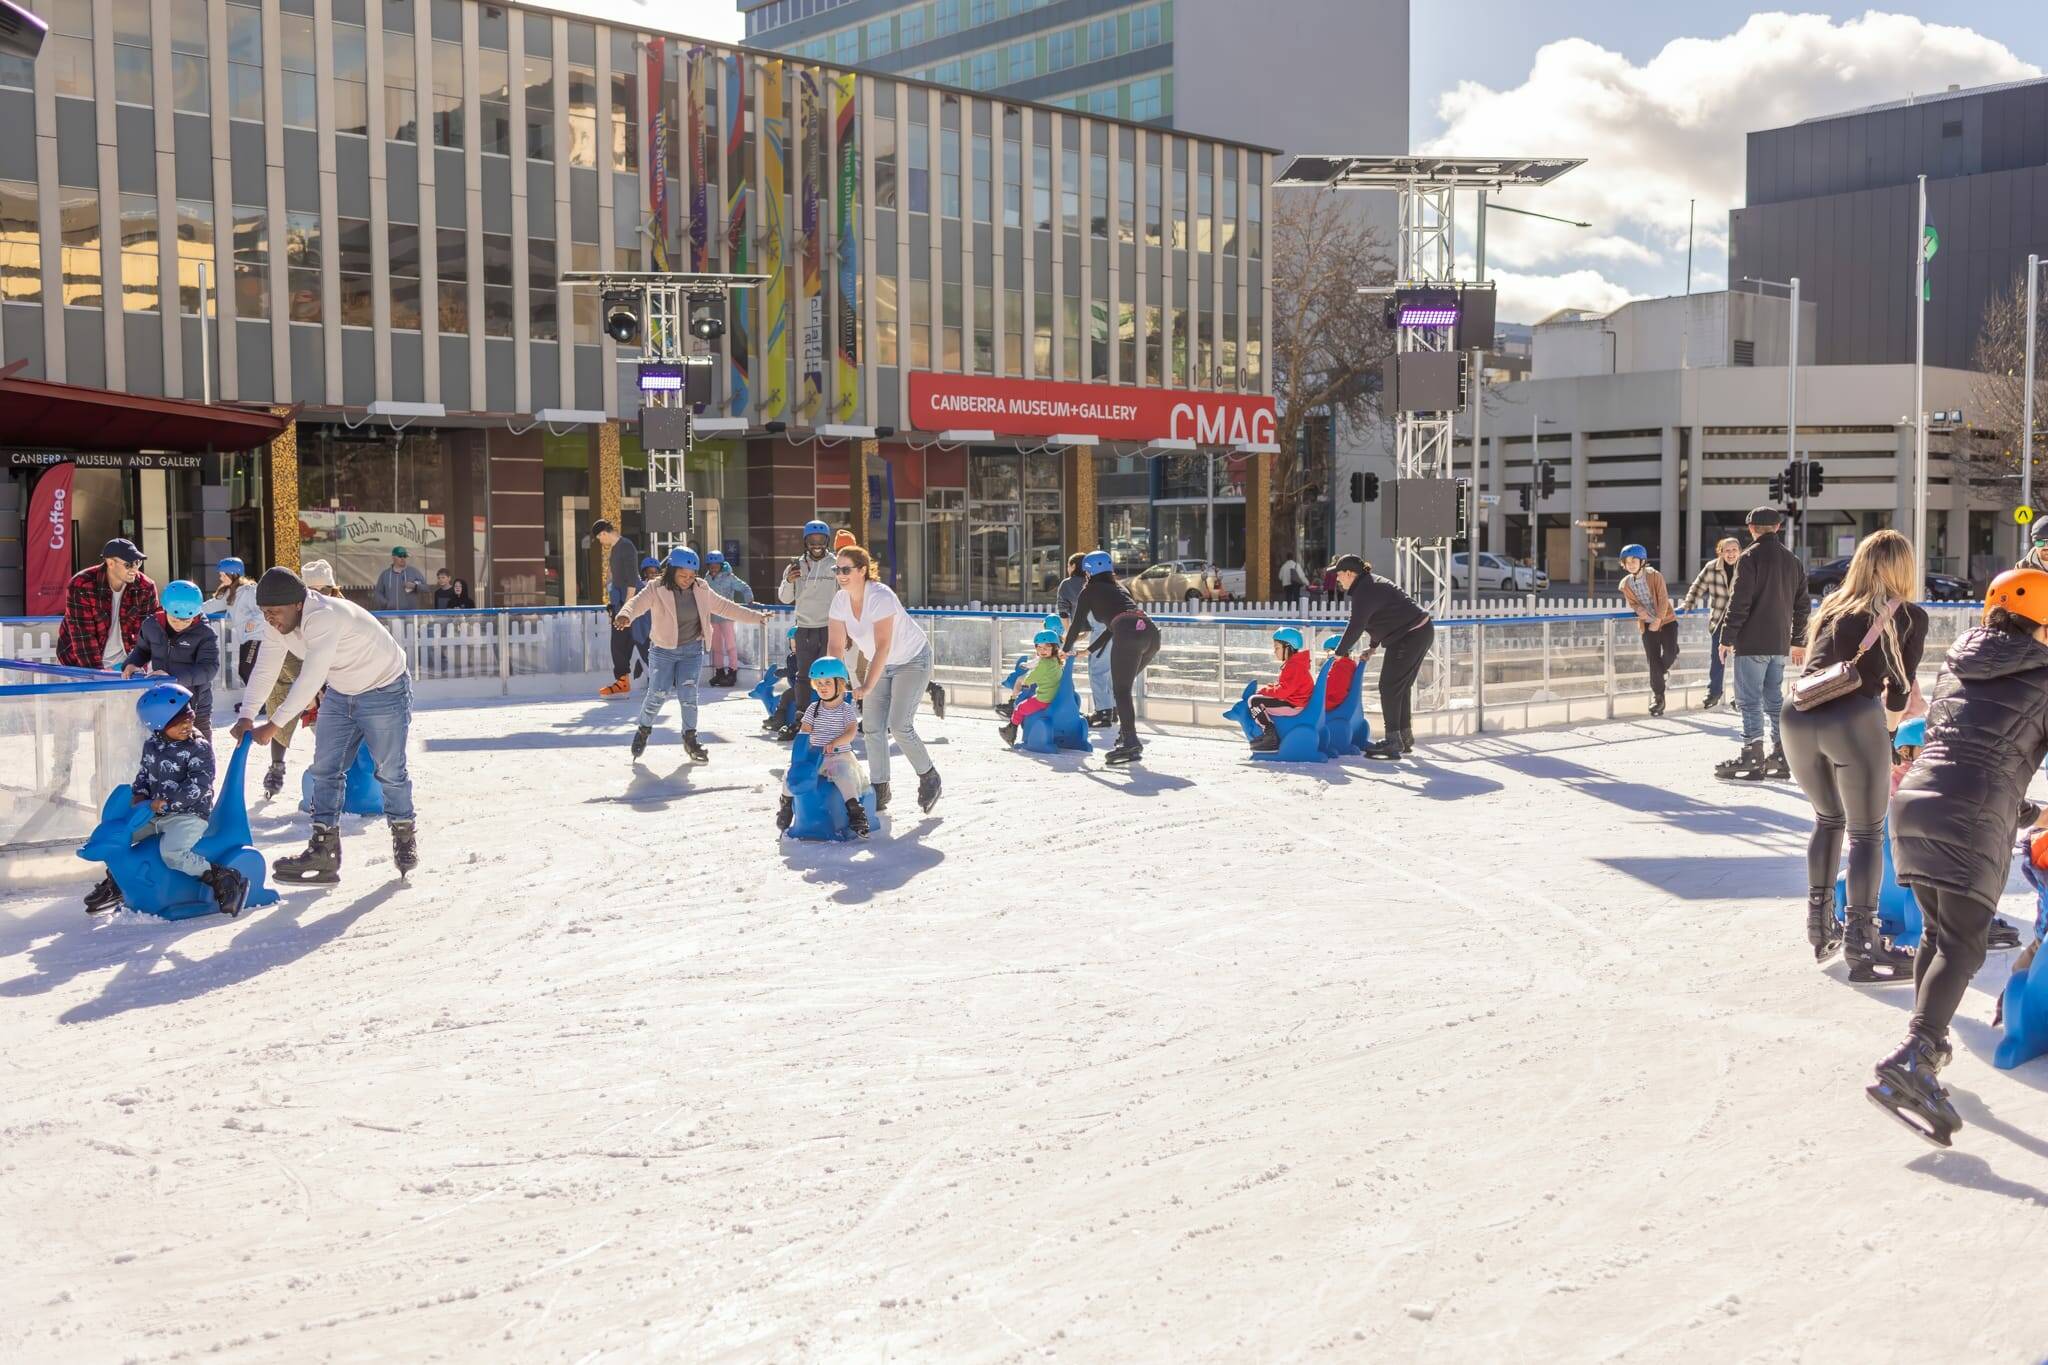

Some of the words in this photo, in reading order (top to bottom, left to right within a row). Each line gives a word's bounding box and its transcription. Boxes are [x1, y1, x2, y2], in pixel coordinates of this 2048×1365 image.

[655, 112, 663, 145] Theo
[655, 149, 664, 203] Notaras
[844, 142, 852, 173] Theo
[844, 176, 852, 226] Notaras
[845, 272, 856, 347] Multicultural
[931, 394, 1006, 414] CANBERRA
[1009, 399, 1138, 421] MUSEUM+GALLERY
[1170, 403, 1275, 446] CMAG
[11, 453, 69, 464] CANBERRA
[76, 455, 123, 466] MUSEUM
[129, 456, 153, 466] AND
[159, 456, 202, 467] GALLERY
[49, 488, 66, 550] Coffee
